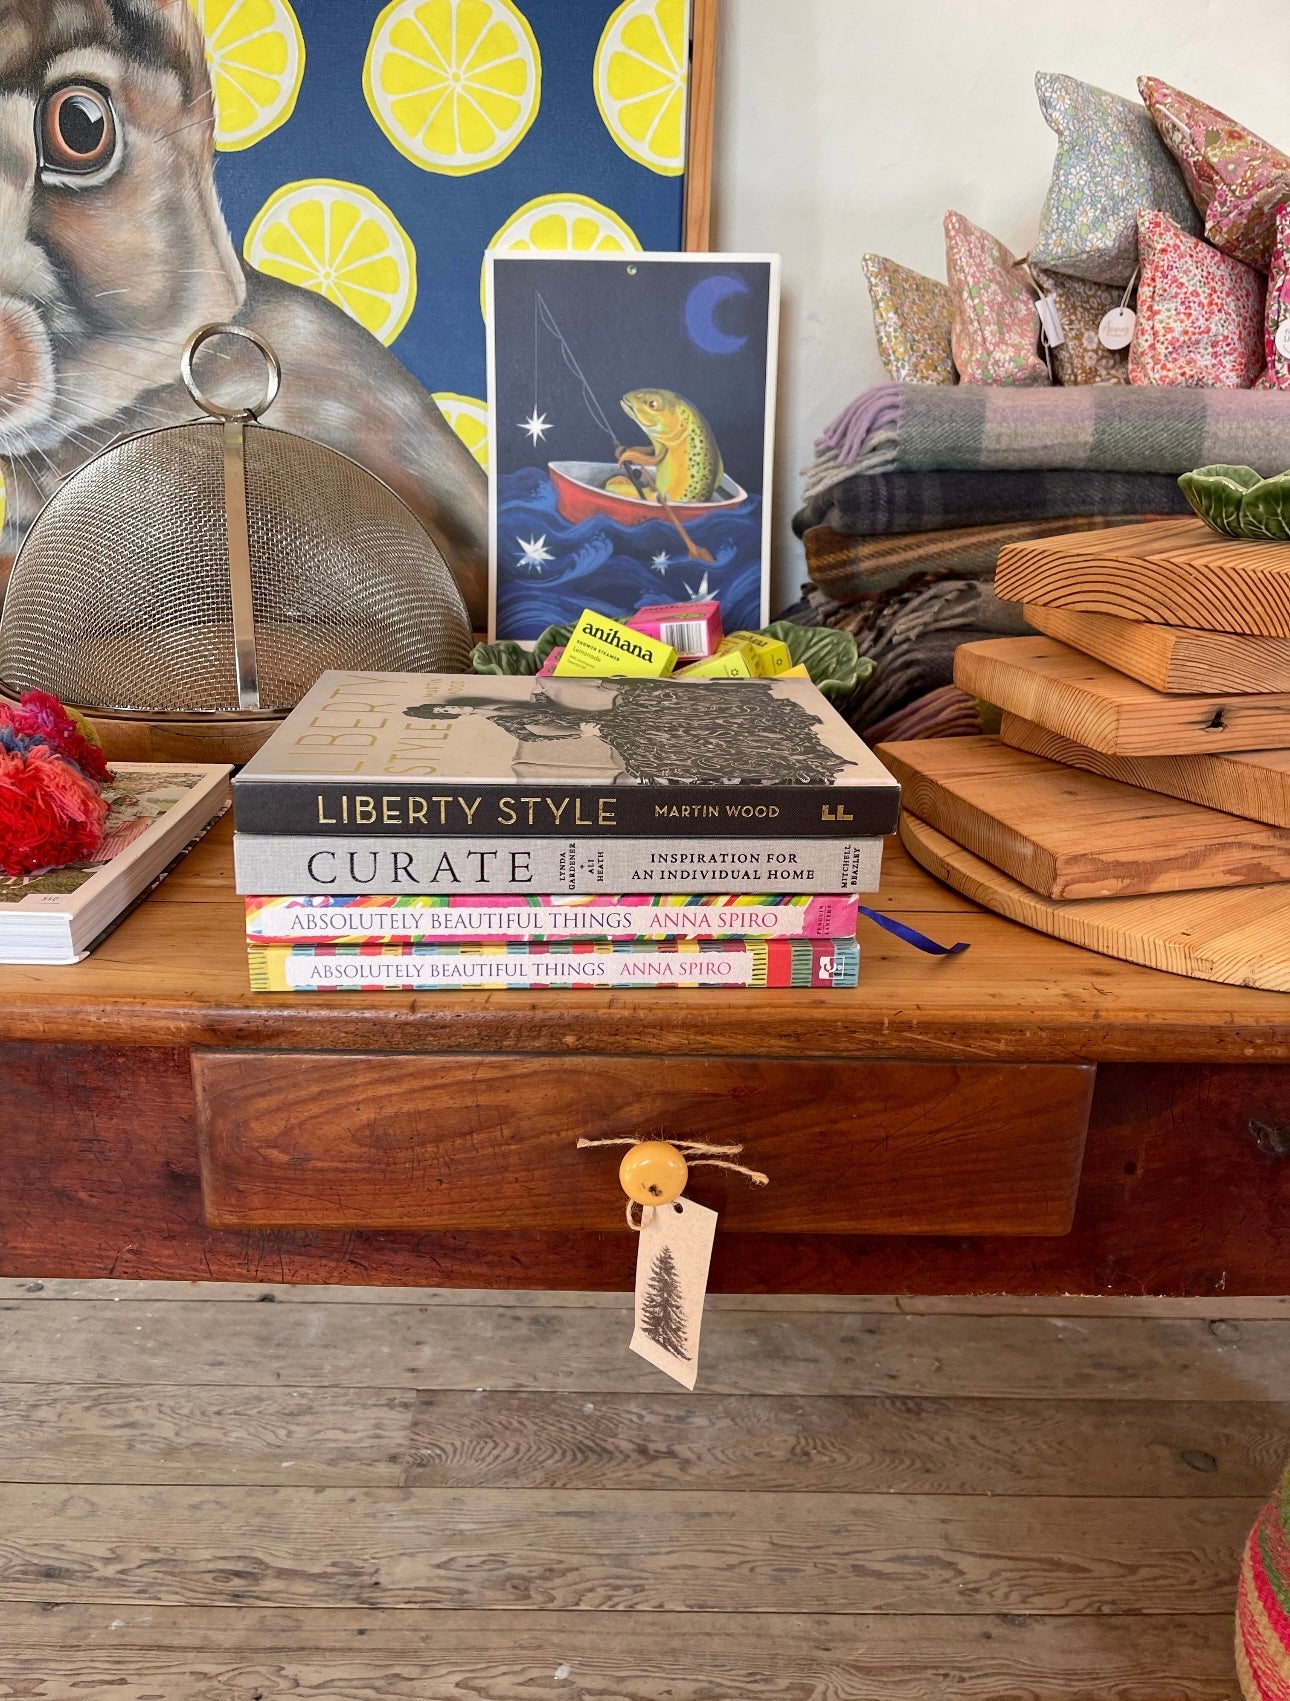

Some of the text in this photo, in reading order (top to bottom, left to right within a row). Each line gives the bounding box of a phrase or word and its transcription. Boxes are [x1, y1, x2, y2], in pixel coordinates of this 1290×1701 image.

[582, 623, 653, 663] anihana
[272, 674, 408, 774] LIBERTY
[384, 722, 452, 775] STYLE
[317, 795, 617, 825] LIBERTY STYLE
[655, 805, 780, 818] MARTIN WOOD
[307, 850, 533, 884] CURATE
[568, 842, 576, 890] GARDENER
[632, 869, 815, 880] AN INDIVIDUAL HOME
[650, 853, 798, 864] INSPIRATION FOR
[841, 844, 851, 889] MITCHELL
[851, 847, 861, 886] BEAZLEY
[291, 912, 778, 930] ABSOLUTELY BEAUTIFUL THINGS ANNA SPIRO
[816, 905, 824, 935] PENGUIN
[310, 961, 732, 979] ABSOLUTELY BEAUTIFUL THINGS ANNA SPIRO
